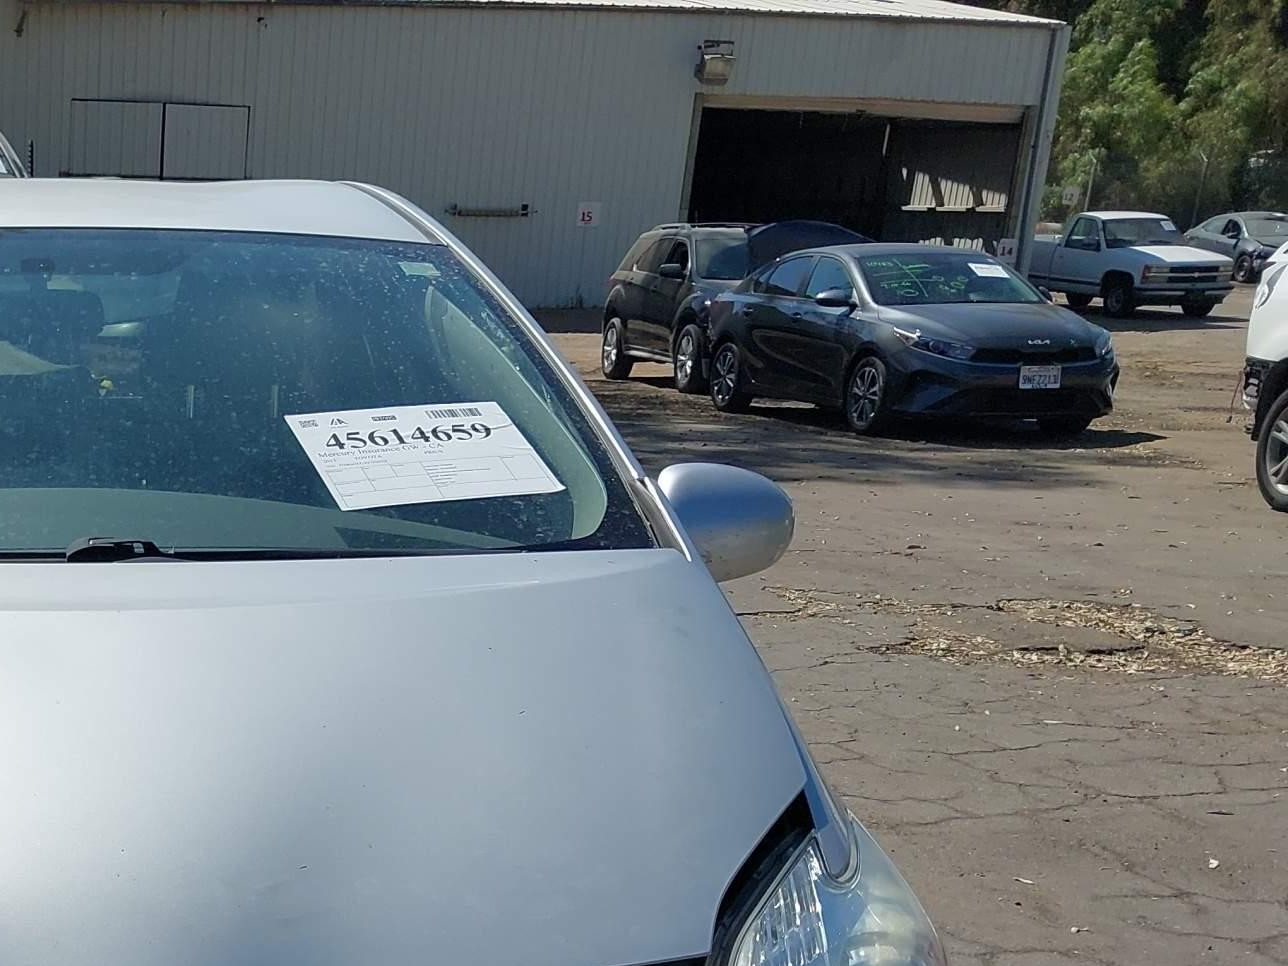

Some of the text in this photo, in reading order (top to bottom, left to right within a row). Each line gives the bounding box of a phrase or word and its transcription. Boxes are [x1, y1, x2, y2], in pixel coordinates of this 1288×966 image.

[581, 211, 593, 221] 15
[1000, 246, 1013, 256] 14
[326, 423, 492, 450] 45614659
[318, 450, 355, 458] Mercury
[358, 446, 400, 455] Insurance
